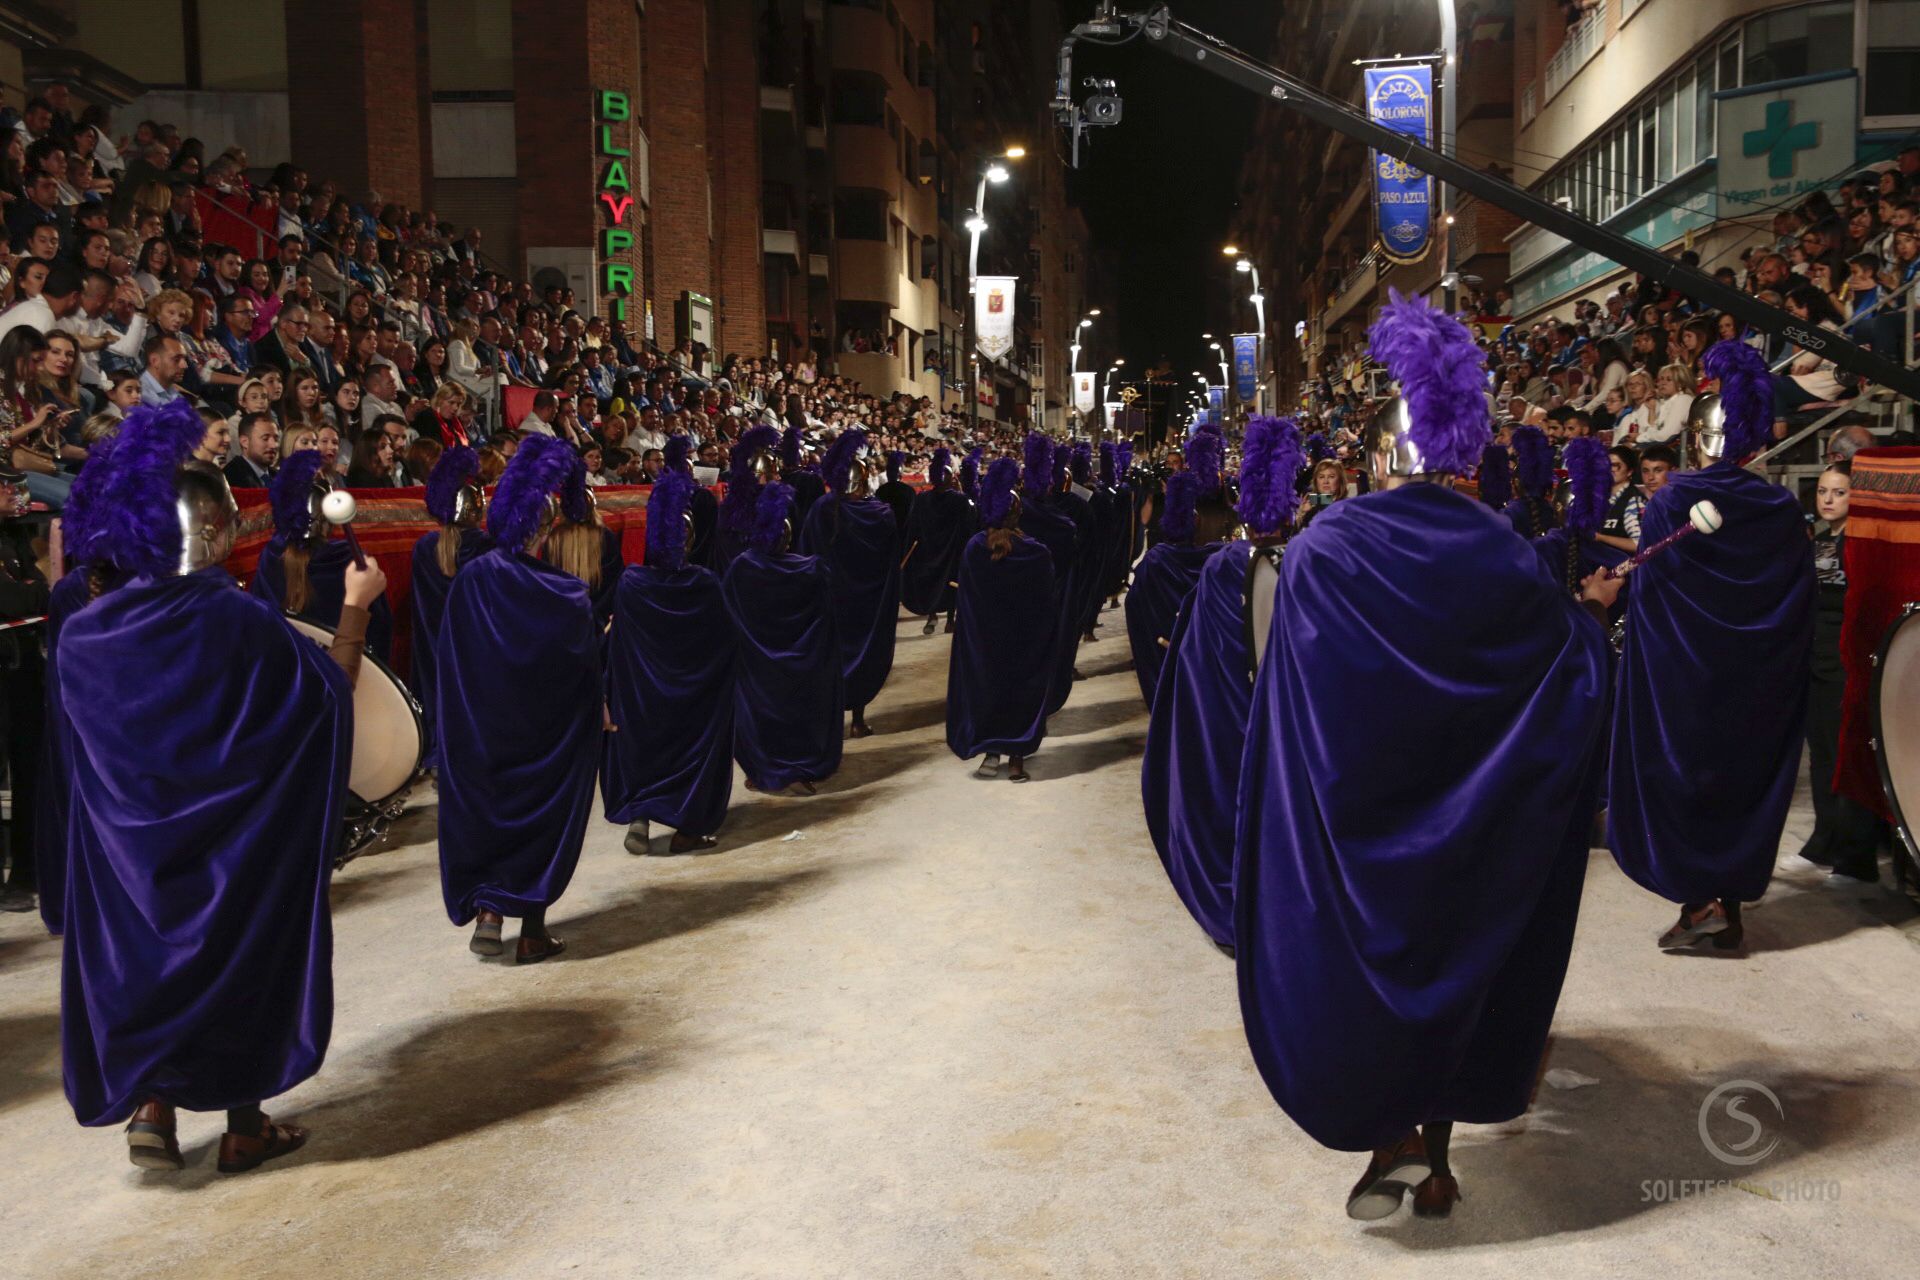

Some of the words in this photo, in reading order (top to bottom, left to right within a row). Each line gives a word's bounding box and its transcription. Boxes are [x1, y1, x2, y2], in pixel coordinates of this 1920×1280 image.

[1377, 81, 1420, 102] MATER
[1375, 105, 1424, 119] DOLOROSA
[1770, 182, 1791, 197] del
[1380, 192, 1401, 203] PASO
[1403, 192, 1427, 203] AZUL
[1782, 326, 1827, 350] SECED
[1603, 519, 1618, 529] 27
